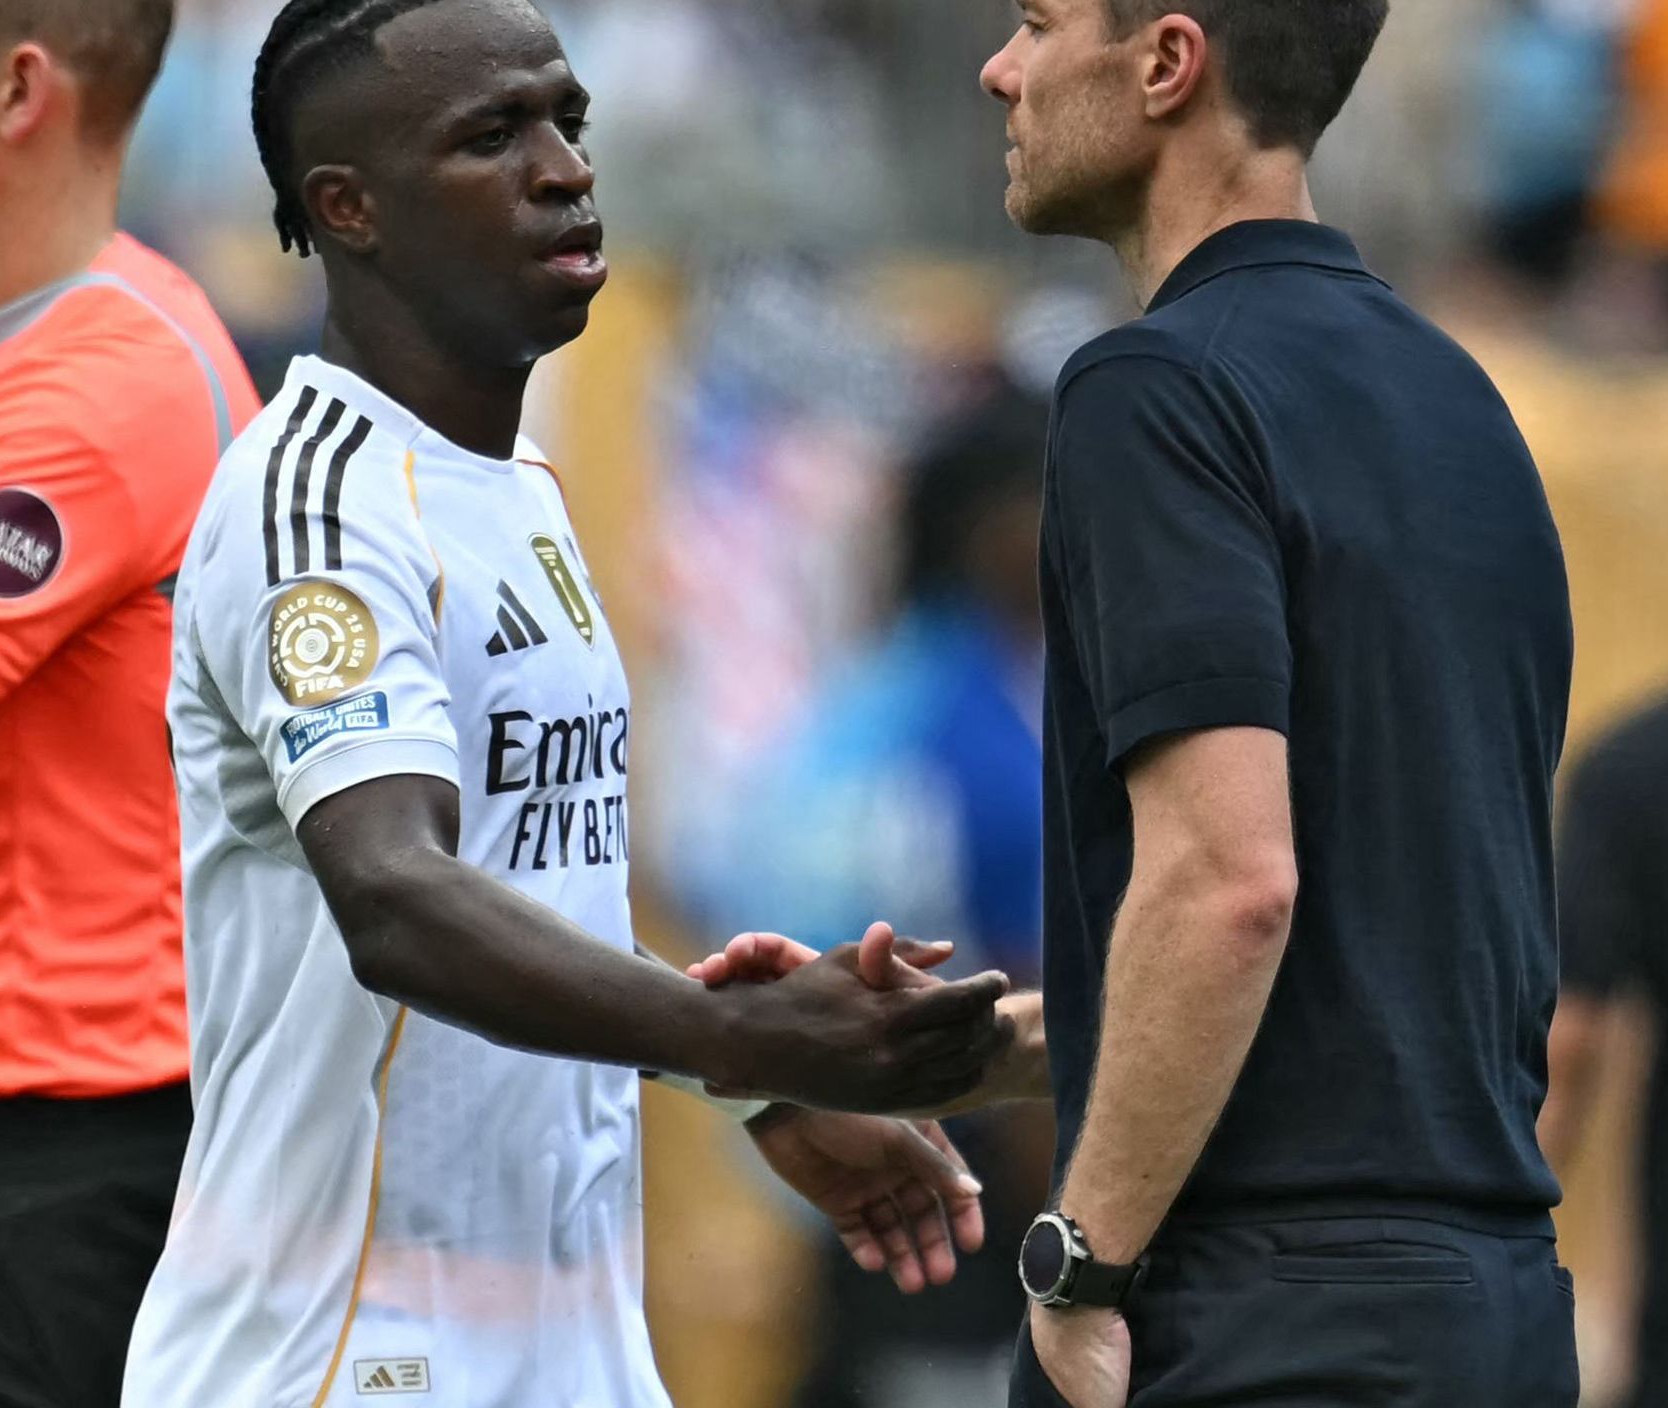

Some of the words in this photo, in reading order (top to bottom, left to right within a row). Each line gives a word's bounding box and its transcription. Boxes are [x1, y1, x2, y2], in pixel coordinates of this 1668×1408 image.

[314, 594, 347, 613] CUP
[272, 597, 308, 648] WORLD
[345, 613, 364, 633] 25
[346, 638, 366, 669] USA
[295, 674, 344, 698] FIFA
[508, 801, 576, 870] FLY
